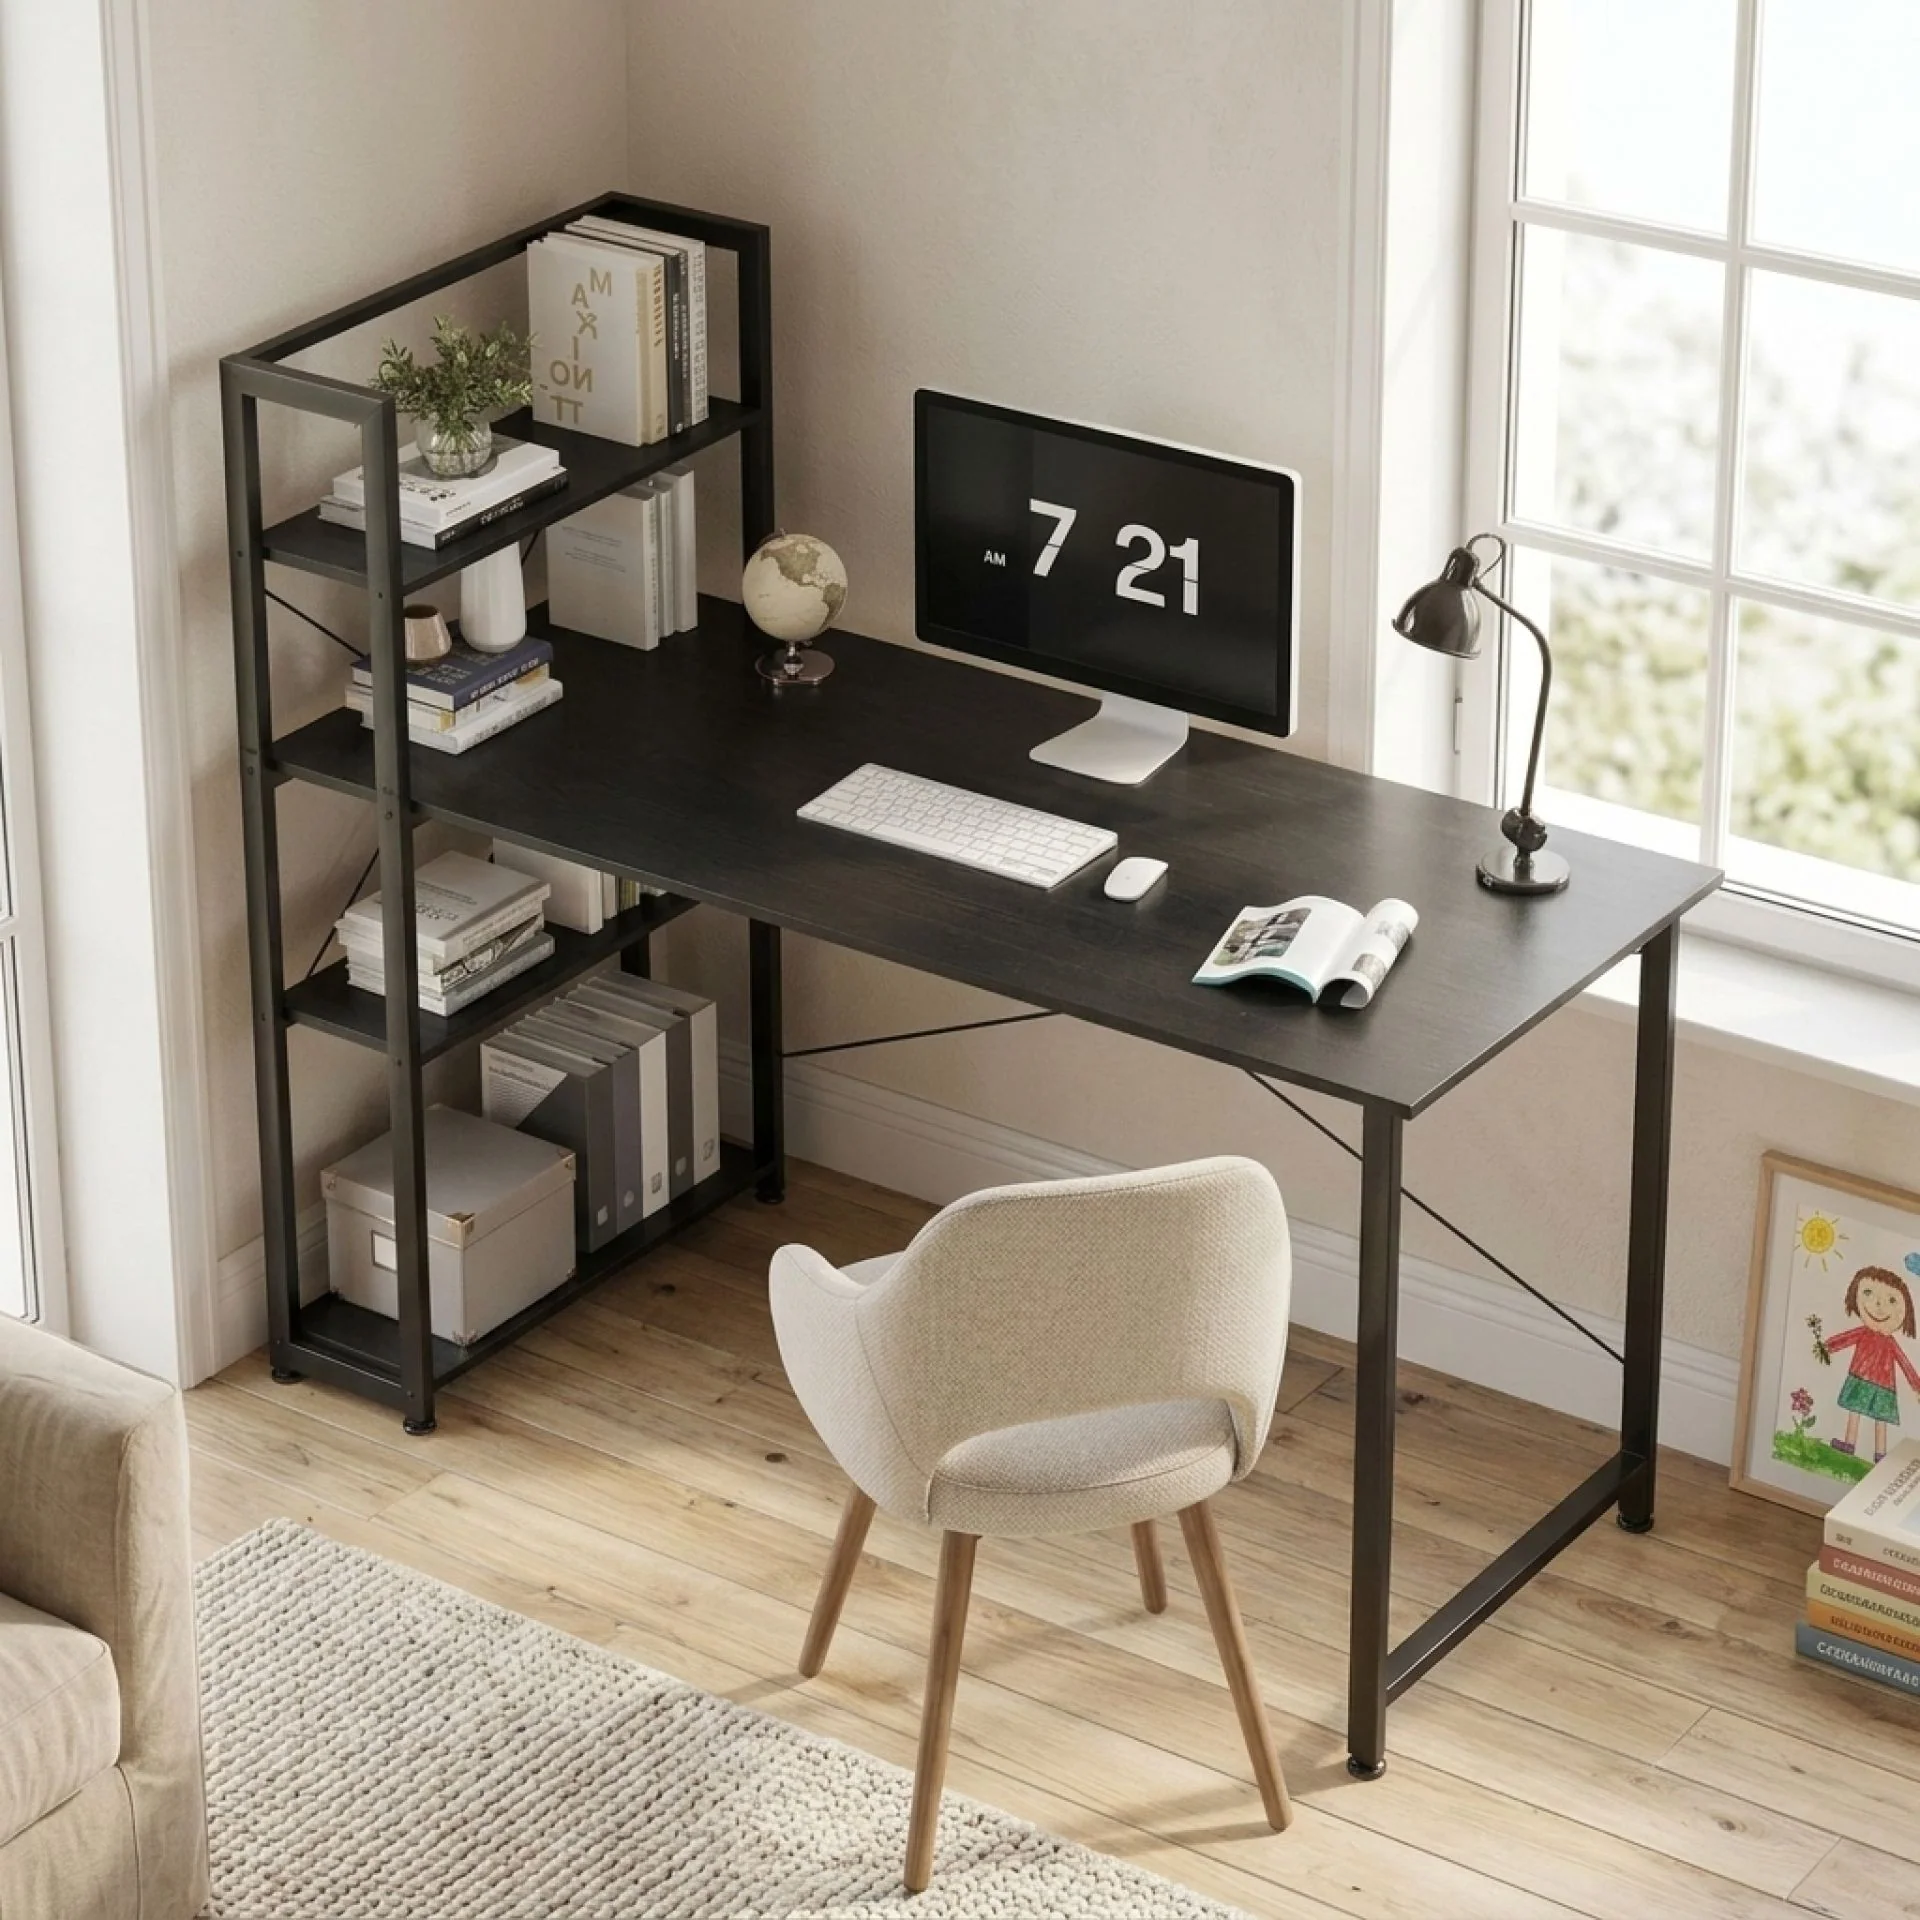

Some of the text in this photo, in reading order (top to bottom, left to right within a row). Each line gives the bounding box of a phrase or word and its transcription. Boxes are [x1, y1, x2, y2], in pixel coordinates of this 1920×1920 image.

[983, 498, 1199, 616] AM 7 21
